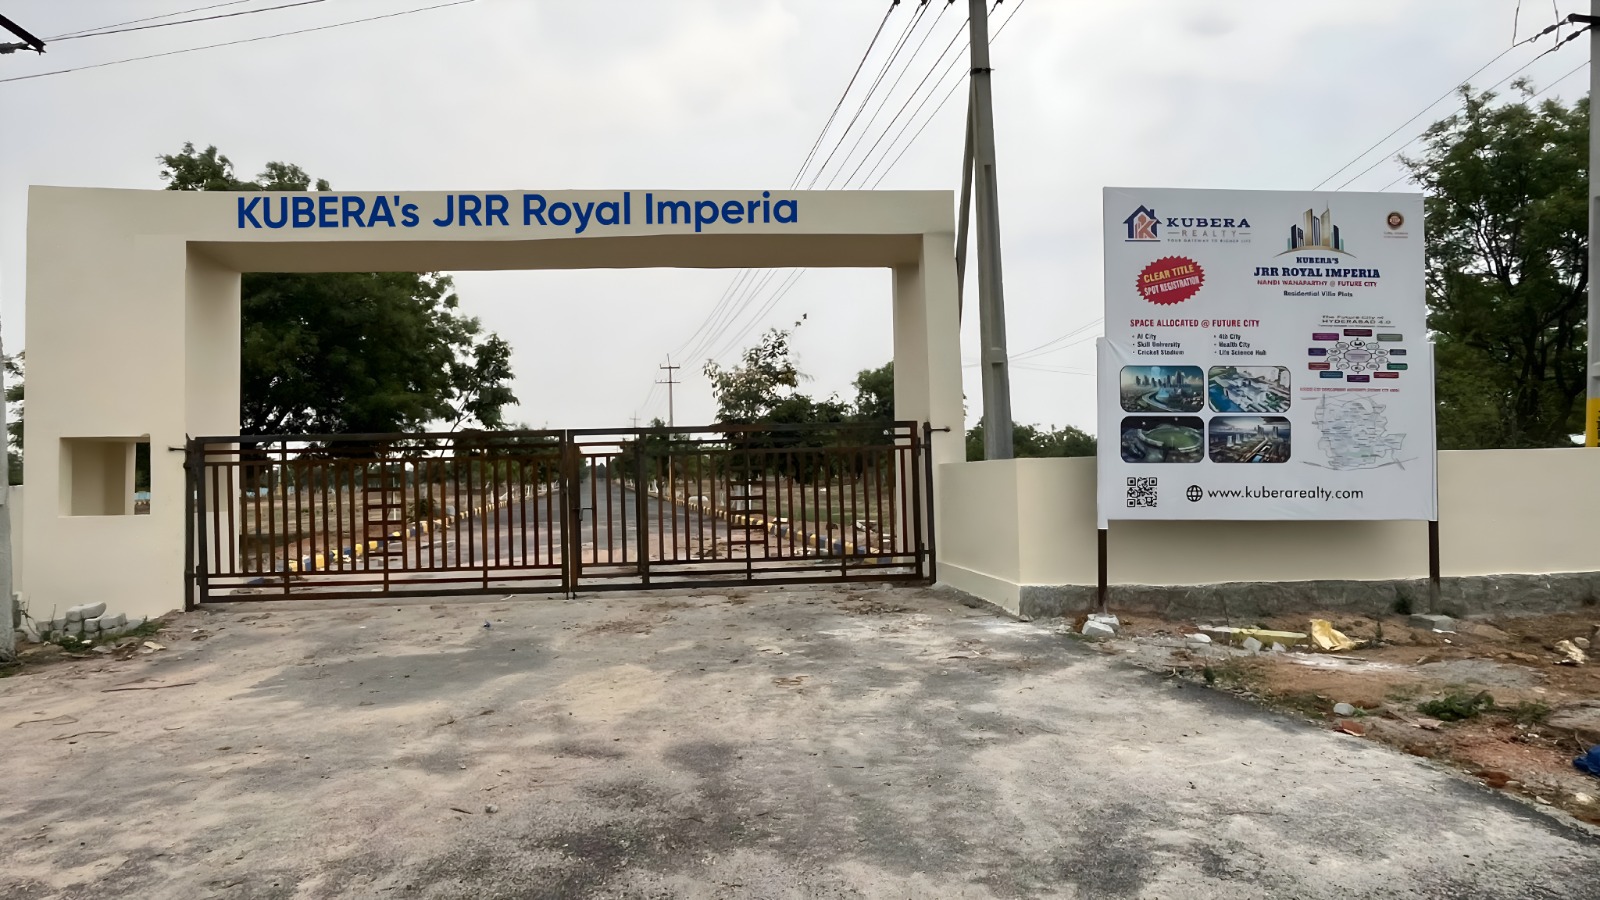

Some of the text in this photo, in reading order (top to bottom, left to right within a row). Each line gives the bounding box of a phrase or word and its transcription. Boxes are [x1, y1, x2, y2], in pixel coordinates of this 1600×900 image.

[237, 191, 799, 234] KUBERA's JRR Royal Imperia
[1166, 217, 1251, 228] KUBERA
[1143, 264, 1195, 284] CLEAR TITLE
[1254, 267, 1381, 279] JRR ROYAL IMPERIA
[1144, 276, 1200, 297] SPOT REGISTRATION
[1130, 319, 1260, 328] SPACE ALLOCATED @ FUTURE CITY
[1145, 333, 1157, 341] City
[1229, 333, 1241, 341] City
[1238, 341, 1250, 349] City
[1207, 486, 1364, 501] www.kuberarealty.com
